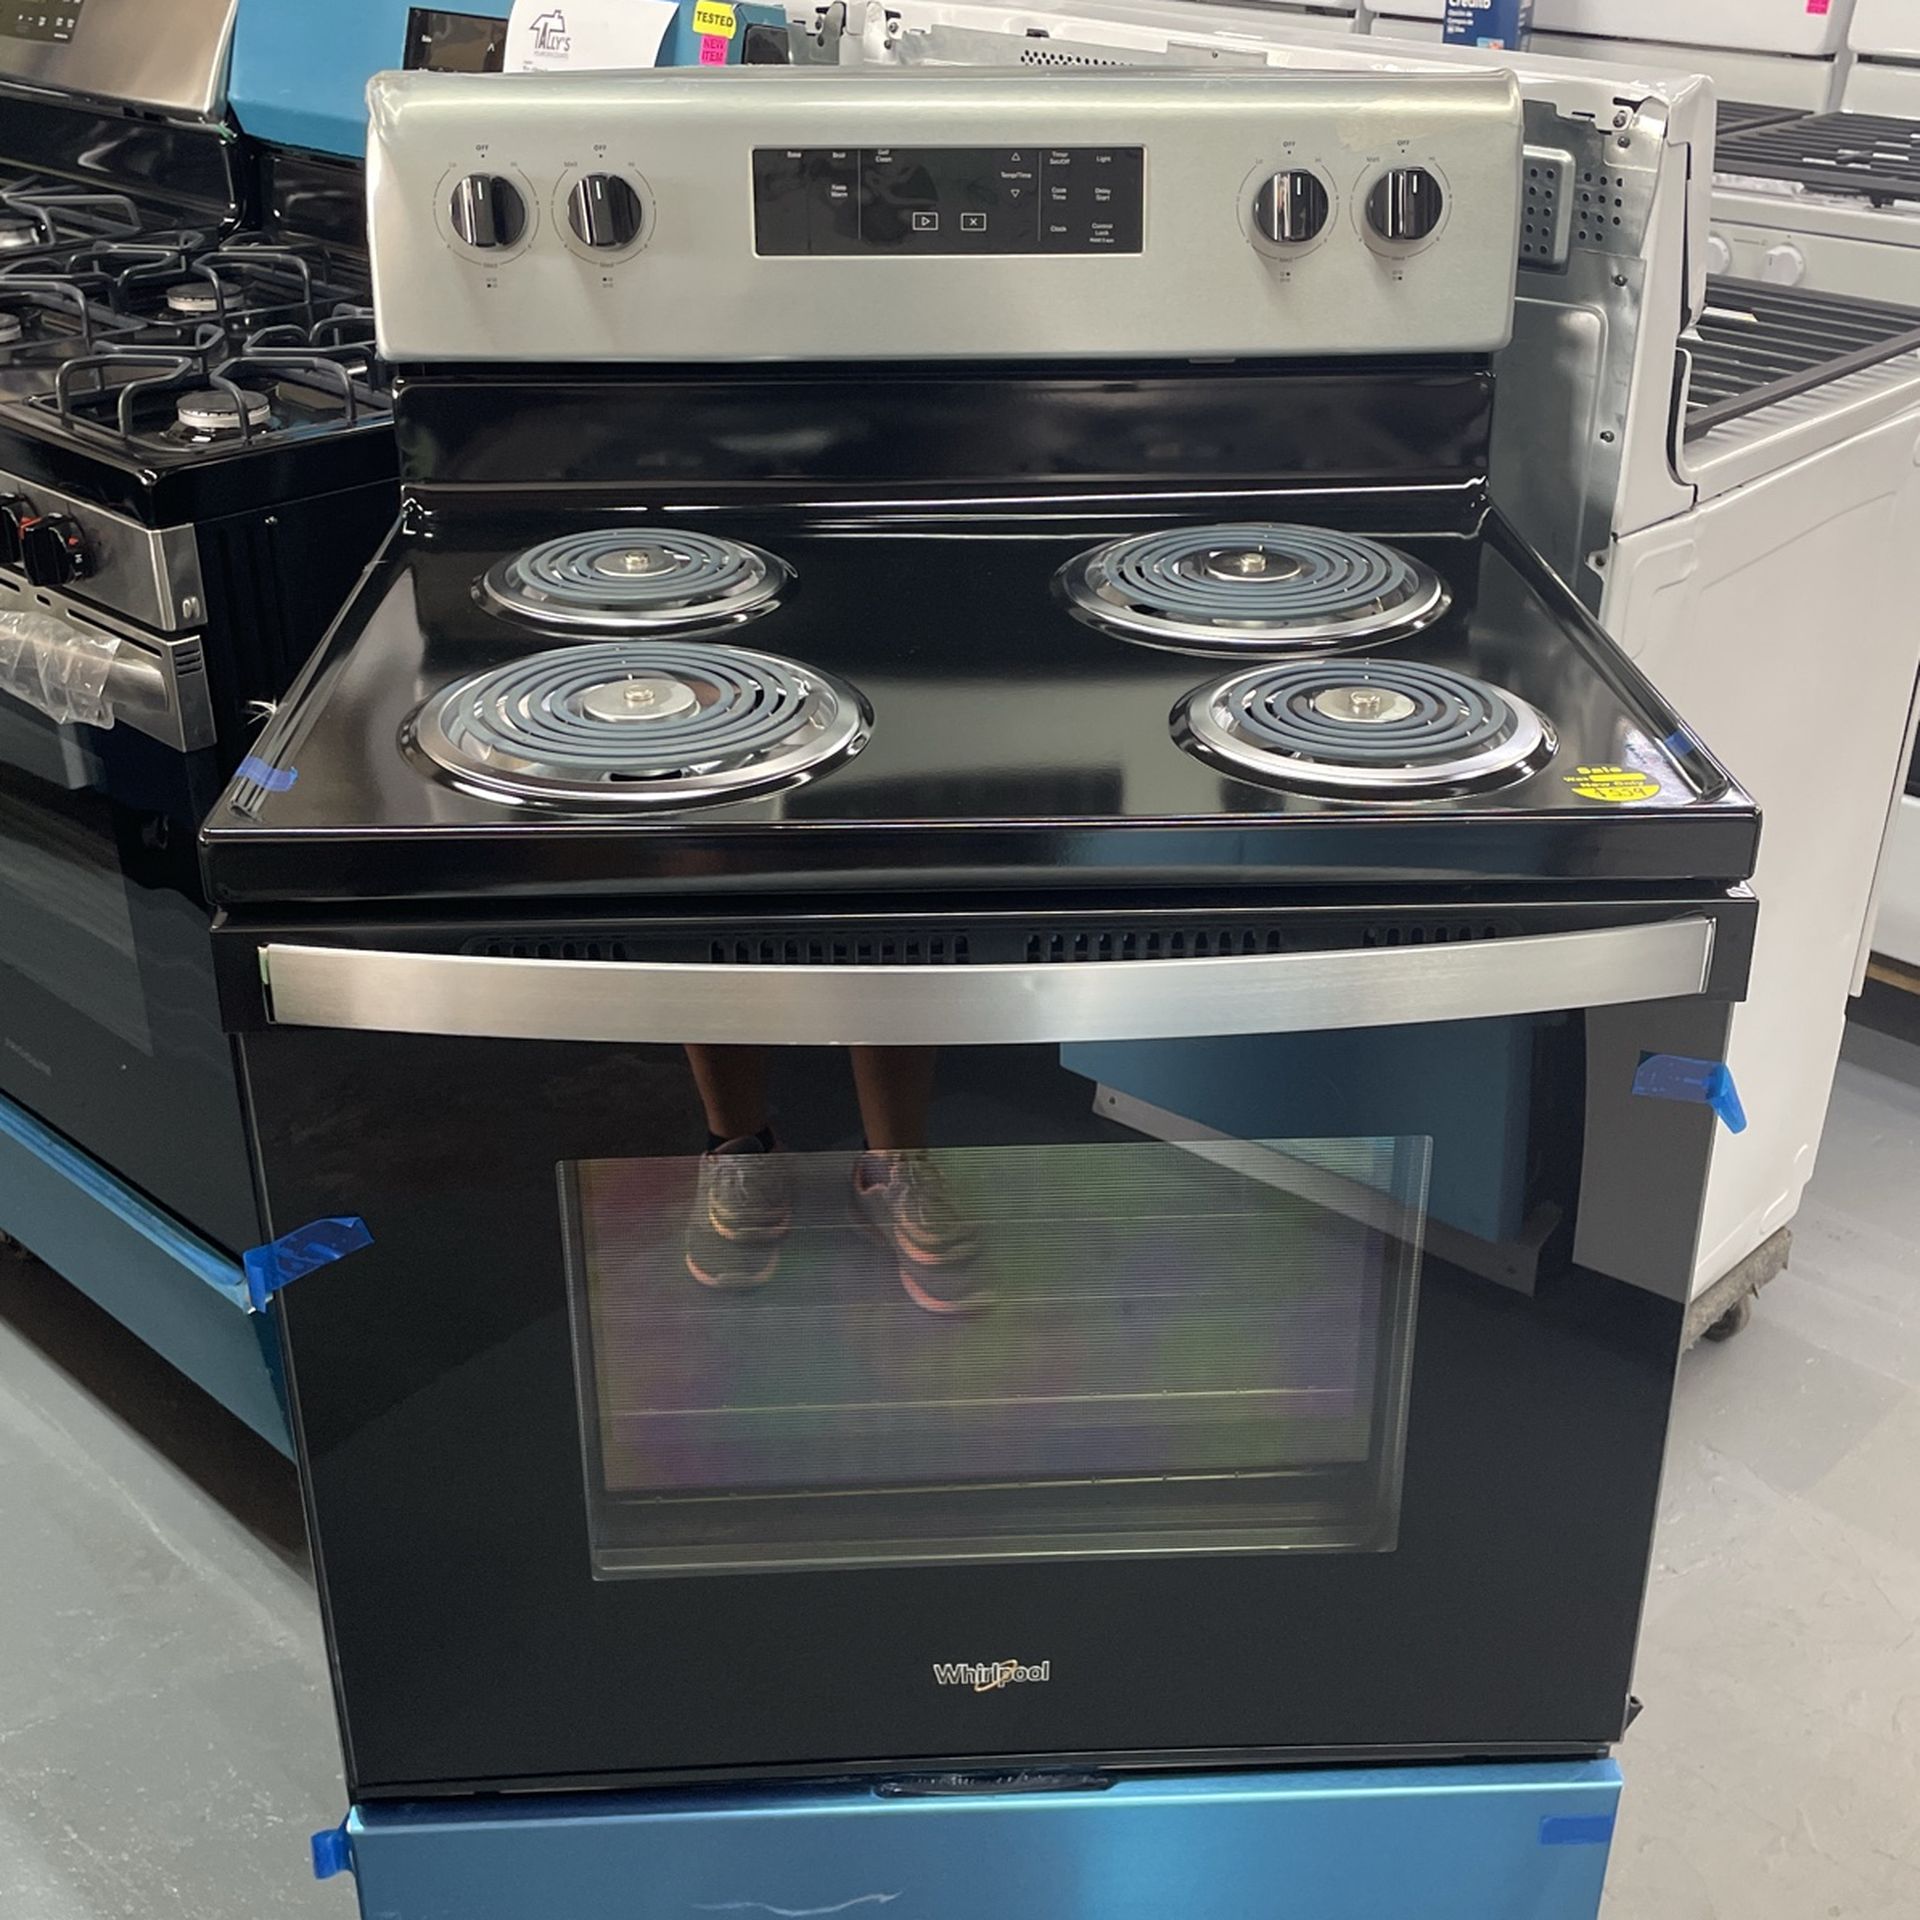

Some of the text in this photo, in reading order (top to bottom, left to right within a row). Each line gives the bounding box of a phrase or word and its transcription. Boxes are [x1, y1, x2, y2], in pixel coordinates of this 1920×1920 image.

[697, 11, 734, 27] TESTED
[530, 10, 571, 51] TALLY'S
[703, 37, 724, 49] NEW
[702, 50, 724, 62] ITEM
[1096, 155, 1111, 163] Light
[1576, 766, 1622, 775] Sale
[933, 1660, 1050, 1689] Whirlpool
